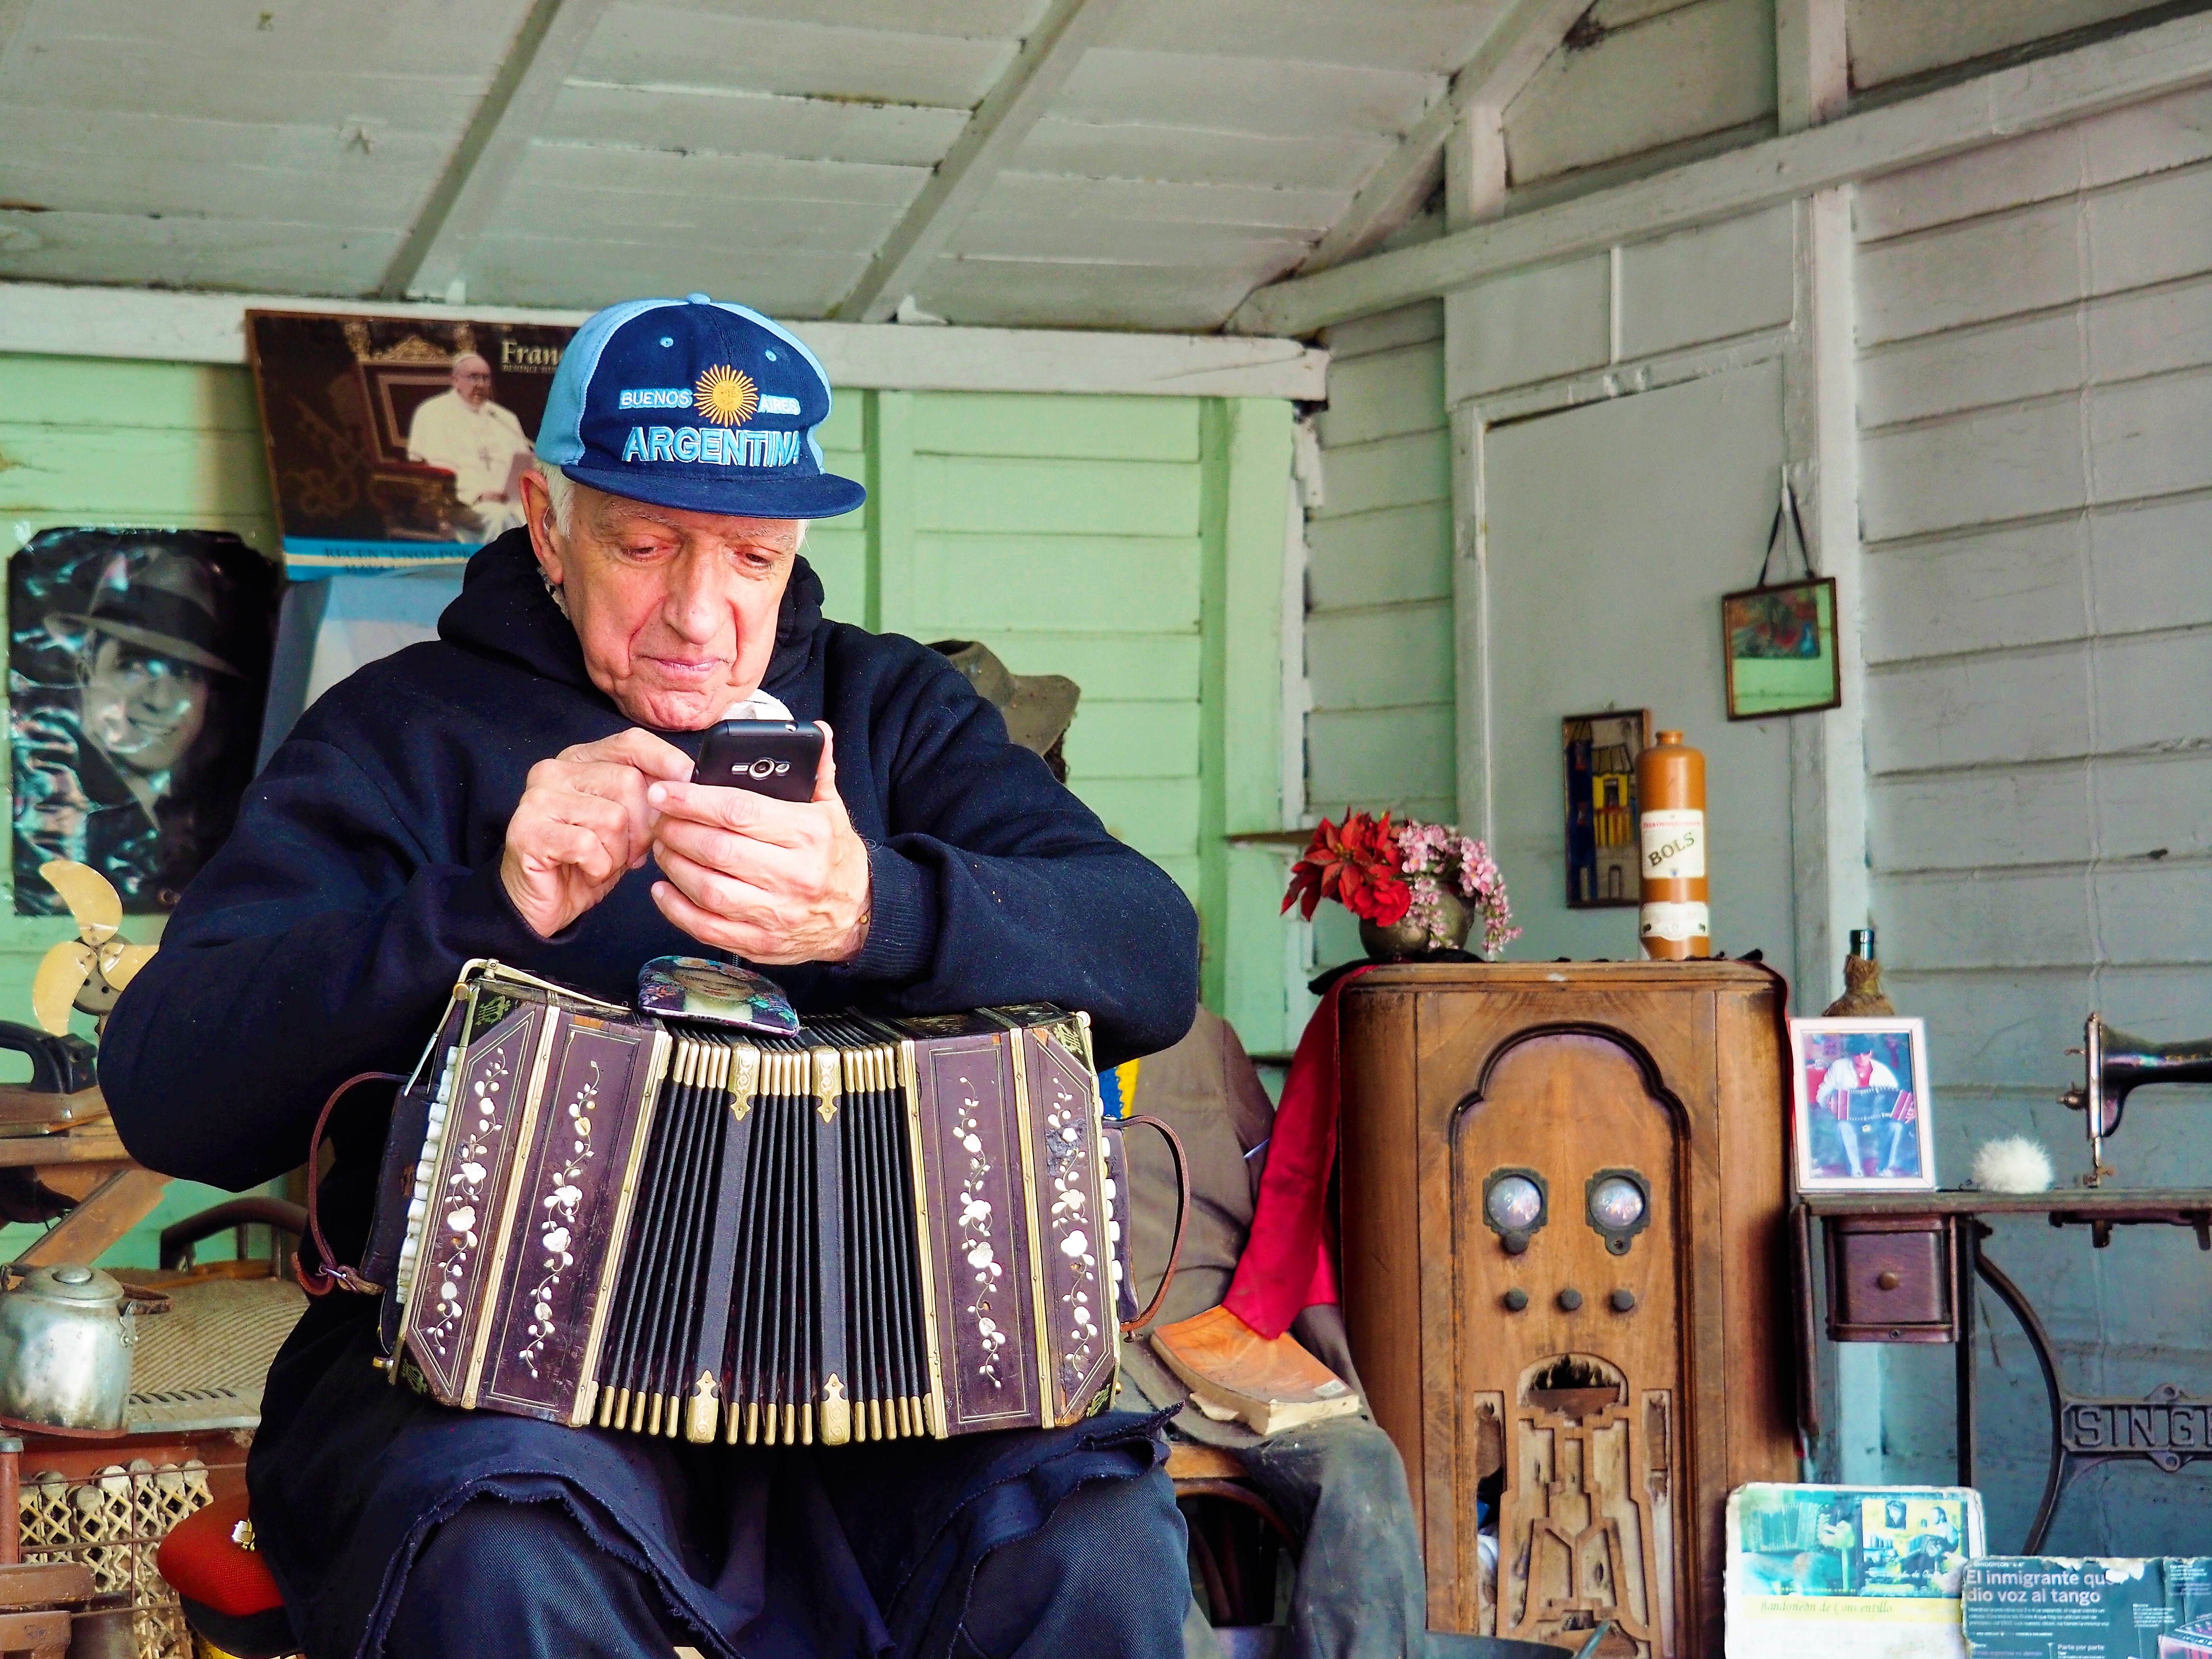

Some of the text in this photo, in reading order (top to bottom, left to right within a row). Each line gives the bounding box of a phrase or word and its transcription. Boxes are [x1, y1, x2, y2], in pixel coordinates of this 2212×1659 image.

[501, 338, 564, 366] Fran
[620, 389, 800, 414] BUENOS AIRES
[622, 426, 801, 467] ARGENTINA
[1648, 832, 1695, 867] BOLS
[2074, 1406, 2212, 1447] SING
[1966, 1569, 2114, 1588] El inmigrante qu
[1819, 1599, 1831, 1612] de
[1966, 1588, 2101, 1606] dio voz al tango
